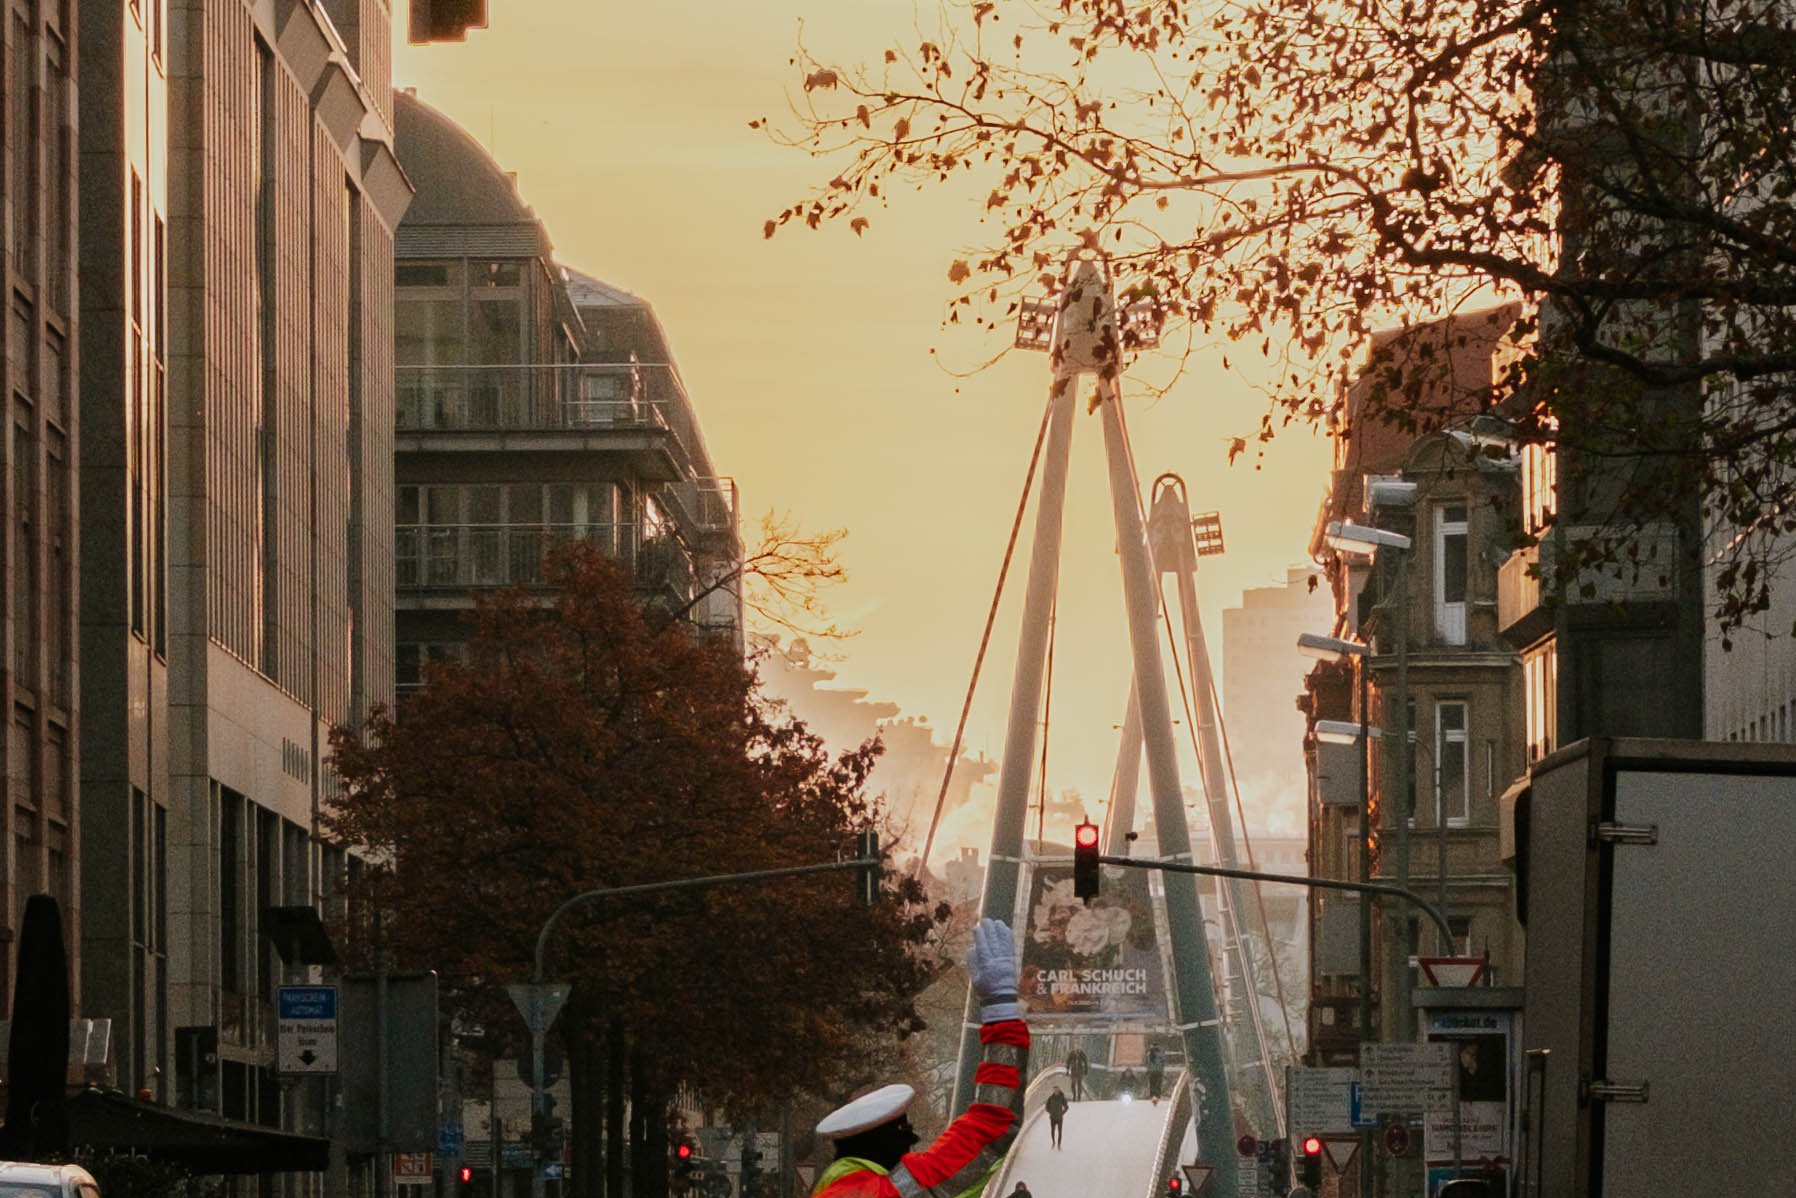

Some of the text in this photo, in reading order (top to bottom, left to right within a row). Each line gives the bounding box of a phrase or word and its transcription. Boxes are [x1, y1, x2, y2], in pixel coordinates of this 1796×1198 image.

[1036, 969, 1147, 982] CARL SCHUCH
[1036, 982, 1147, 995] & FRANKREICH
